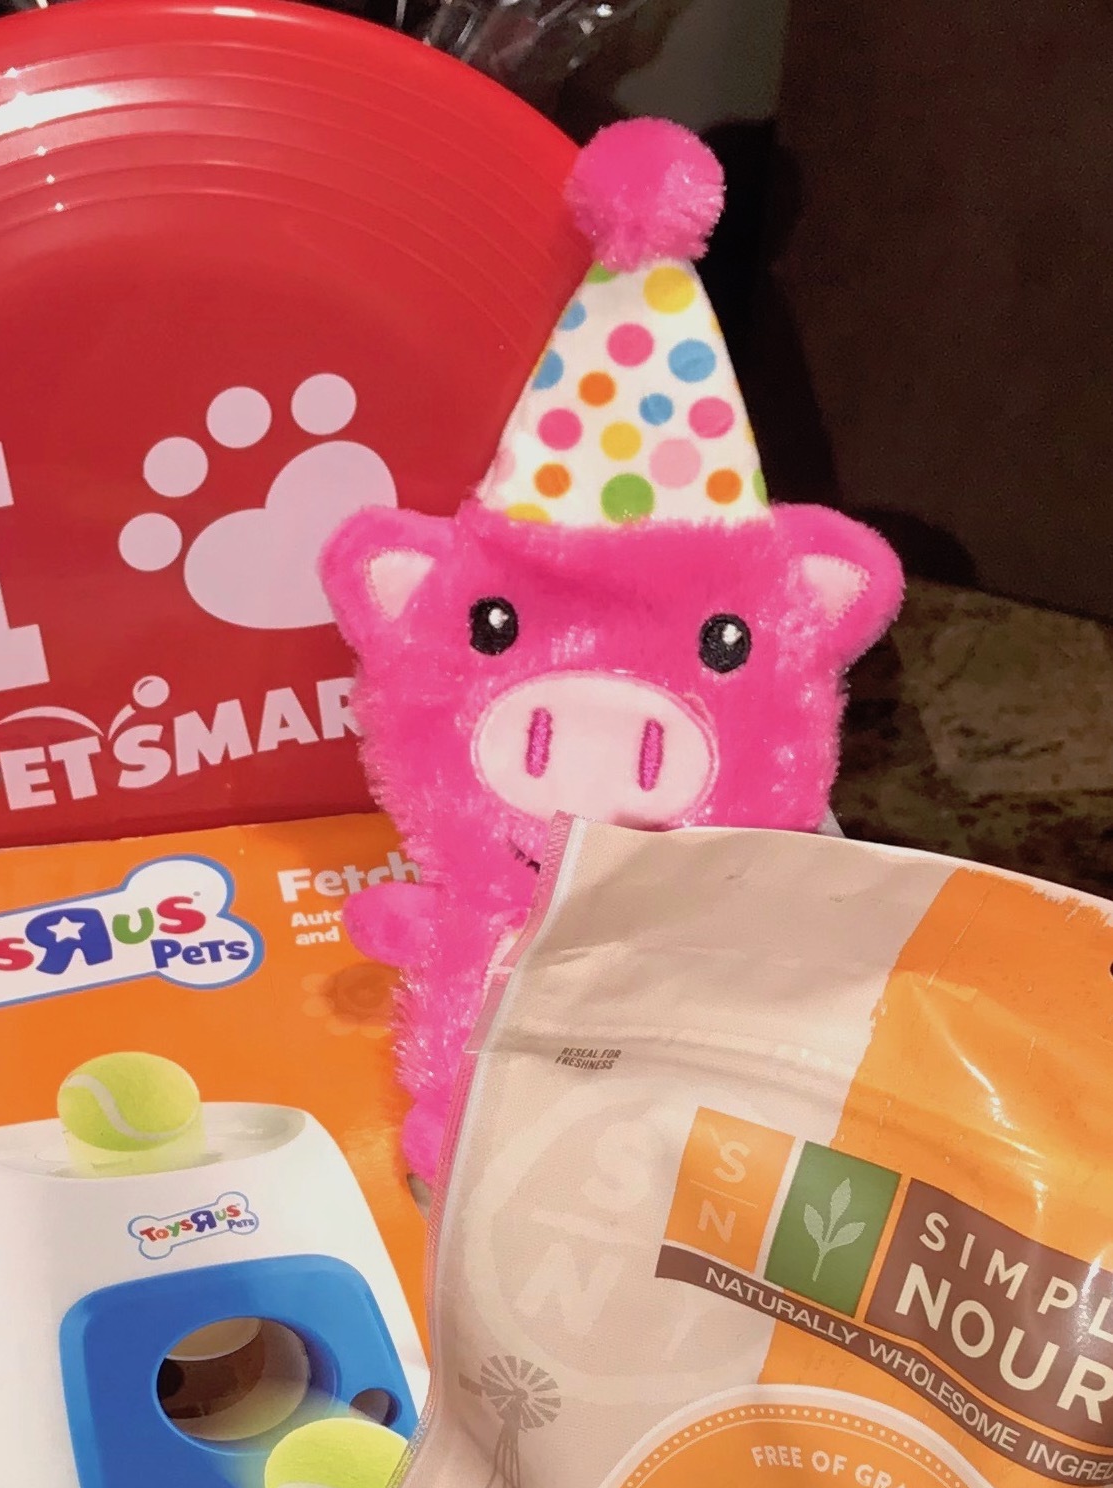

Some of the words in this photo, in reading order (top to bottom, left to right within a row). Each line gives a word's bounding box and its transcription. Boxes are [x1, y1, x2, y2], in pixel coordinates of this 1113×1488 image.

[277, 851, 421, 903] Fetch
[290, 909, 344, 928] Auto
[295, 925, 341, 946] and
[555, 1055, 616, 1071] FRESHNESS
[560, 1047, 598, 1059] RESEAL
[600, 1048, 622, 1060] FOR
[713, 1140, 752, 1184] S
[697, 1199, 737, 1244] N
[918, 1211, 1113, 1344] SIMPL
[894, 1262, 1113, 1424] NOUR
[704, 1266, 860, 1345] NATURALLY
[868, 1338, 1022, 1453] WHOLESOME
[1026, 1439, 1113, 1482] INGRED
[750, 1444, 804, 1469] FREE
[812, 1449, 848, 1475] OF
